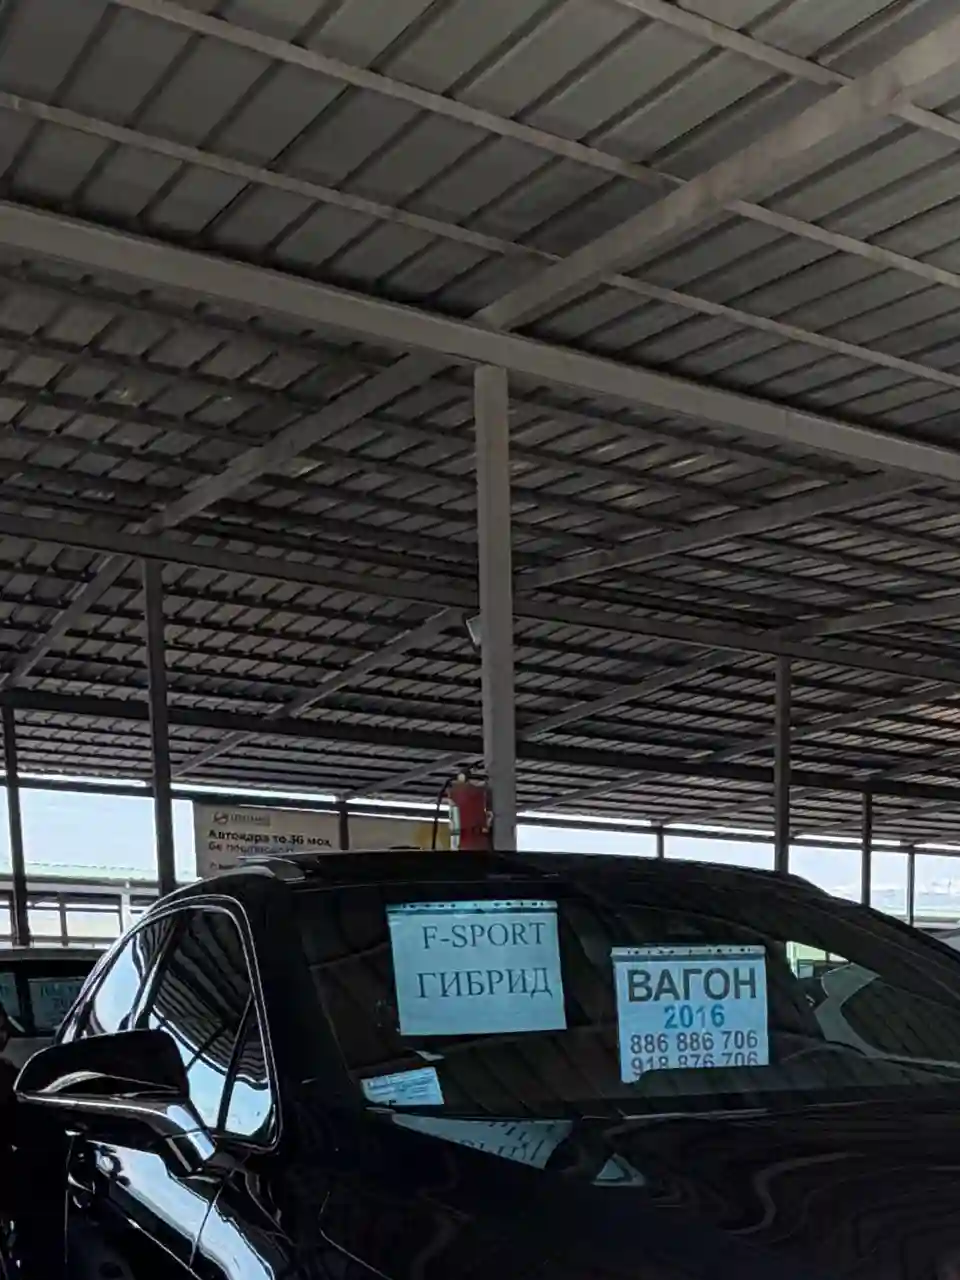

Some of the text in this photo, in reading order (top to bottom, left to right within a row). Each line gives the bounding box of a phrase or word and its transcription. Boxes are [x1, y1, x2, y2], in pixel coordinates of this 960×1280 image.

[422, 922, 546, 949] F-SPORT
[417, 967, 553, 999] ГИБРИД
[627, 967, 757, 1002] ВАГОН
[664, 1004, 725, 1030] 2016
[630, 1030, 758, 1055] 886 886 706
